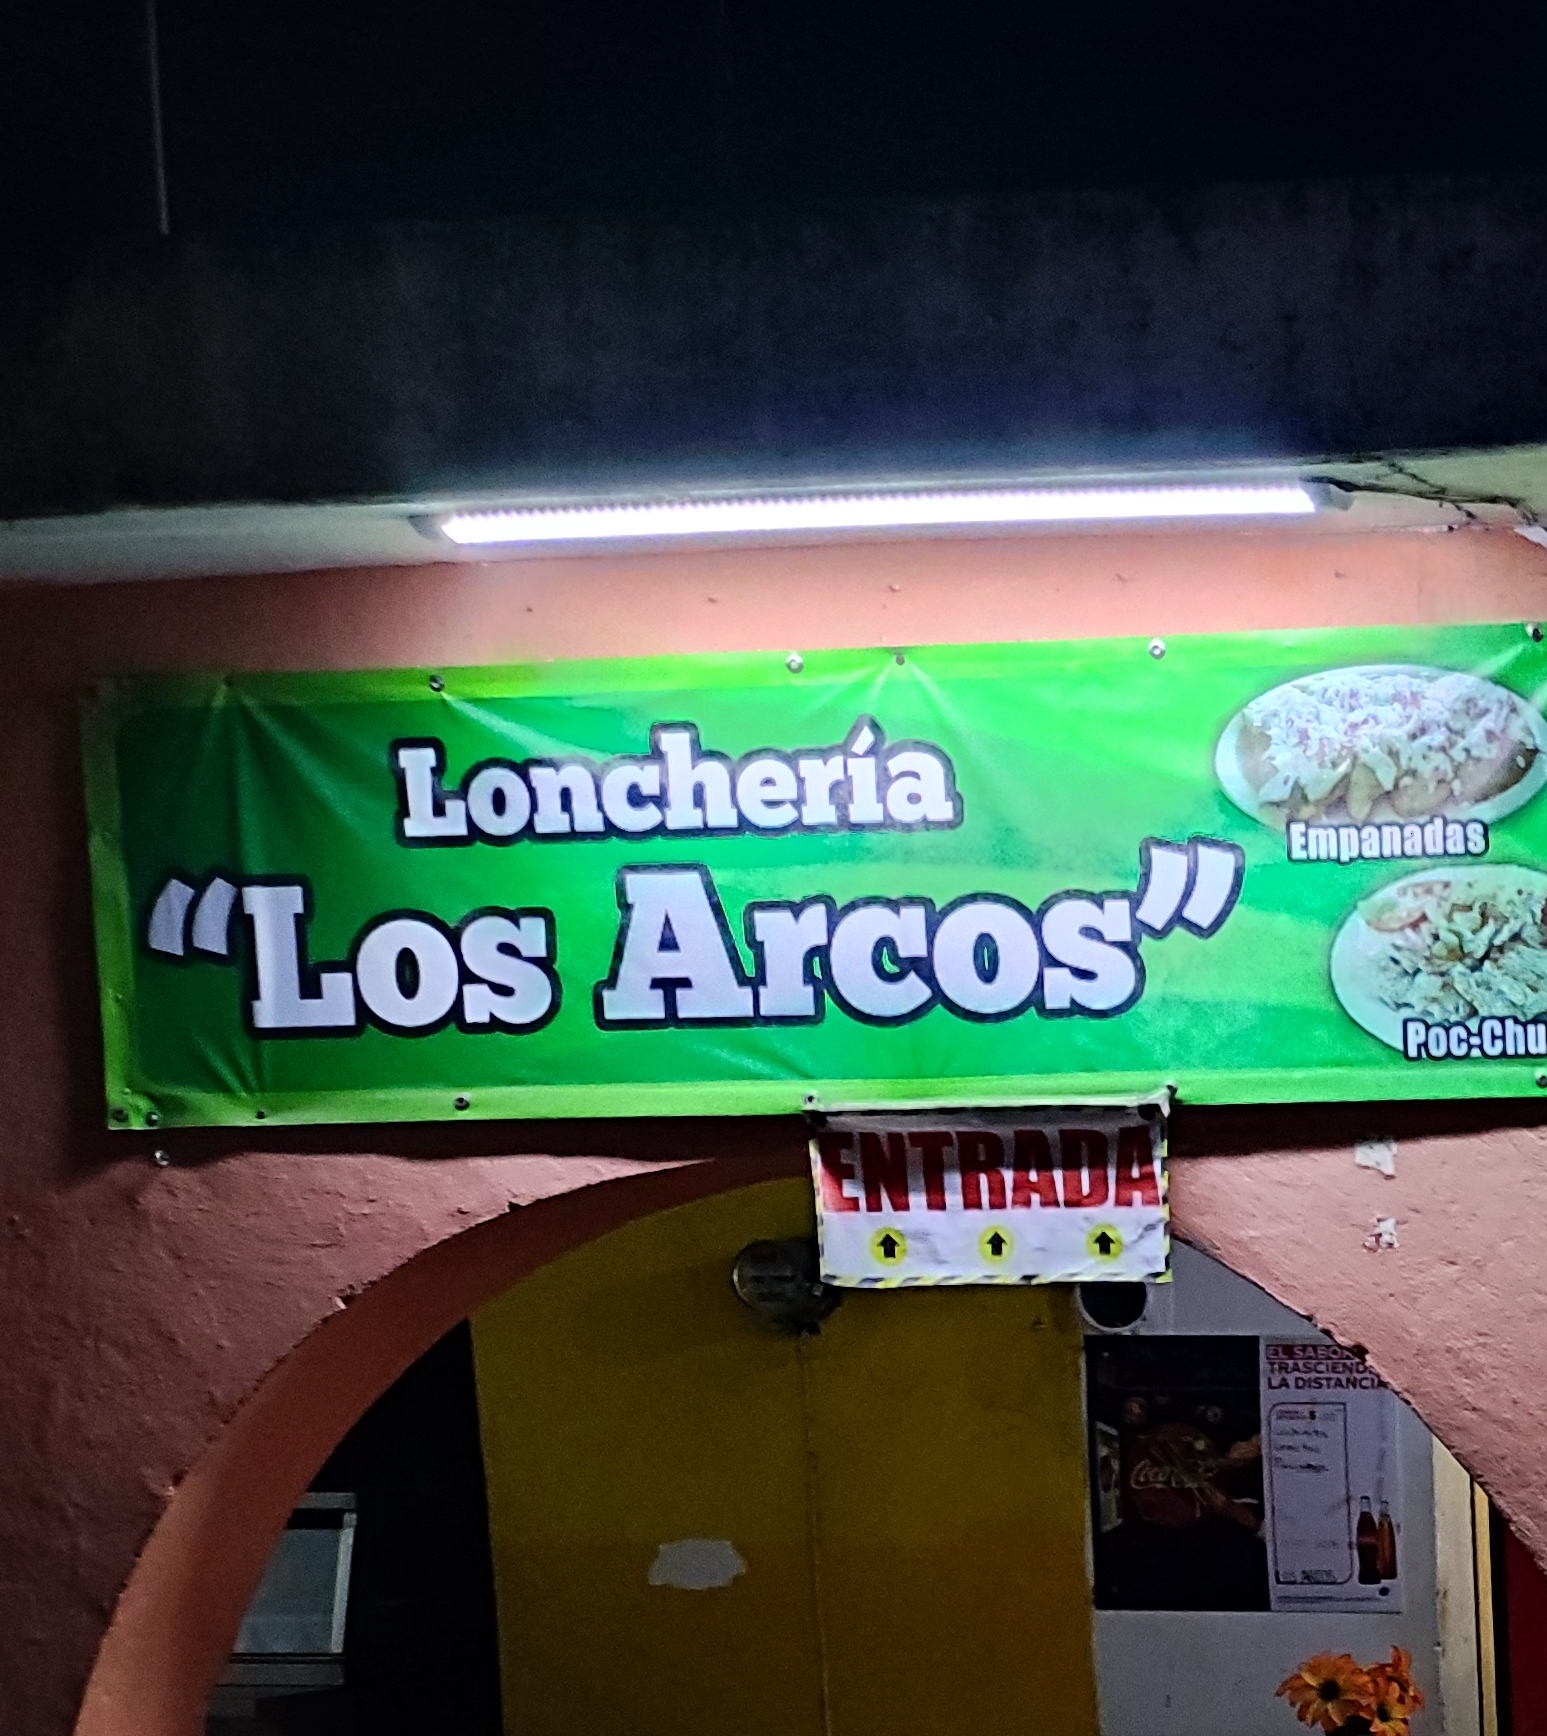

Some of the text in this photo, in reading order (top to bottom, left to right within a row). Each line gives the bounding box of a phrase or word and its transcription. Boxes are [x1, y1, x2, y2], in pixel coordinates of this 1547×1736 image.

[398, 726, 954, 838] Lonchería
[1289, 822, 1486, 861] Empanadas
[818, 1125, 1160, 1212] ENTRADA
[1267, 1361, 1372, 1375] TRASCIEND
[1267, 1376, 1378, 1389] LA DISTANCI
